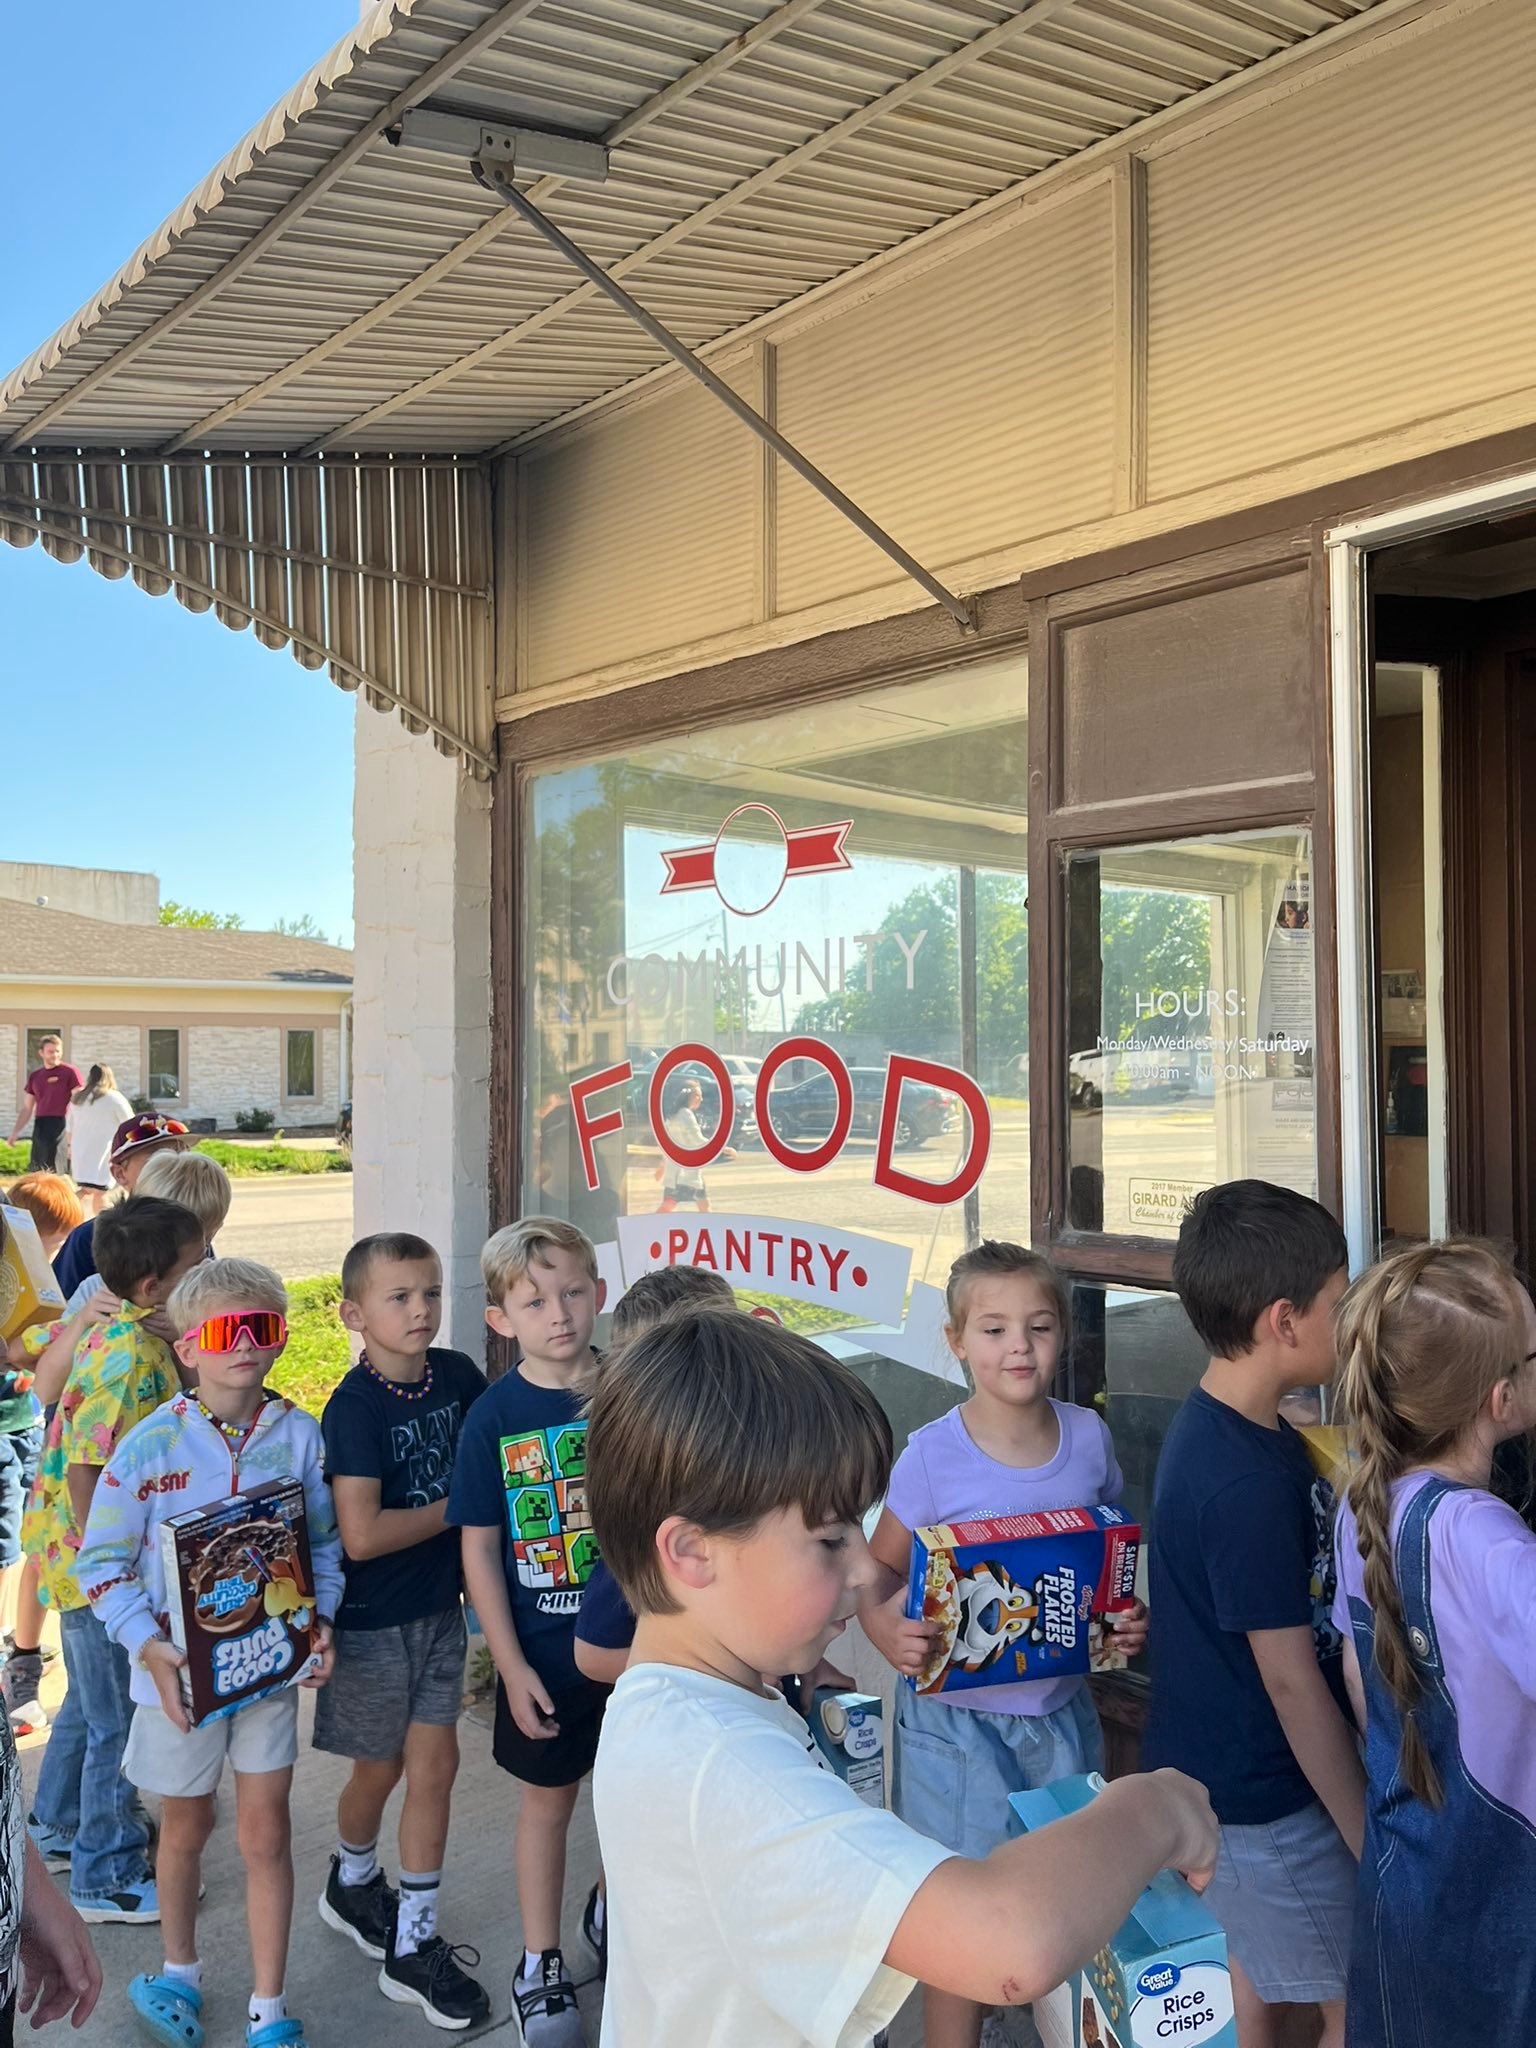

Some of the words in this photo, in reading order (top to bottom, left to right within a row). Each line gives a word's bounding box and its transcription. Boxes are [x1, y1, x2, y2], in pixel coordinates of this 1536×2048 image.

[606, 929, 928, 1006] COMMUNITY
[1135, 988, 1246, 1018] HOURS:
[569, 1036, 993, 1206] FOOD
[1132, 1192, 1177, 1207] GIRARD
[1123, 1545, 1137, 1572] SAVE
[1112, 1554, 1125, 1598] BREAKFAST
[1043, 1573, 1061, 1644] FLAKES
[1059, 1566, 1076, 1649] FROSTED
[217, 1640, 293, 1693] Cocoa
[1140, 1967, 1174, 1987] Great
[1149, 1978, 1174, 1991] Value
[1163, 1990, 1206, 2016] Rice
[1156, 2007, 1215, 2038] Crisps
